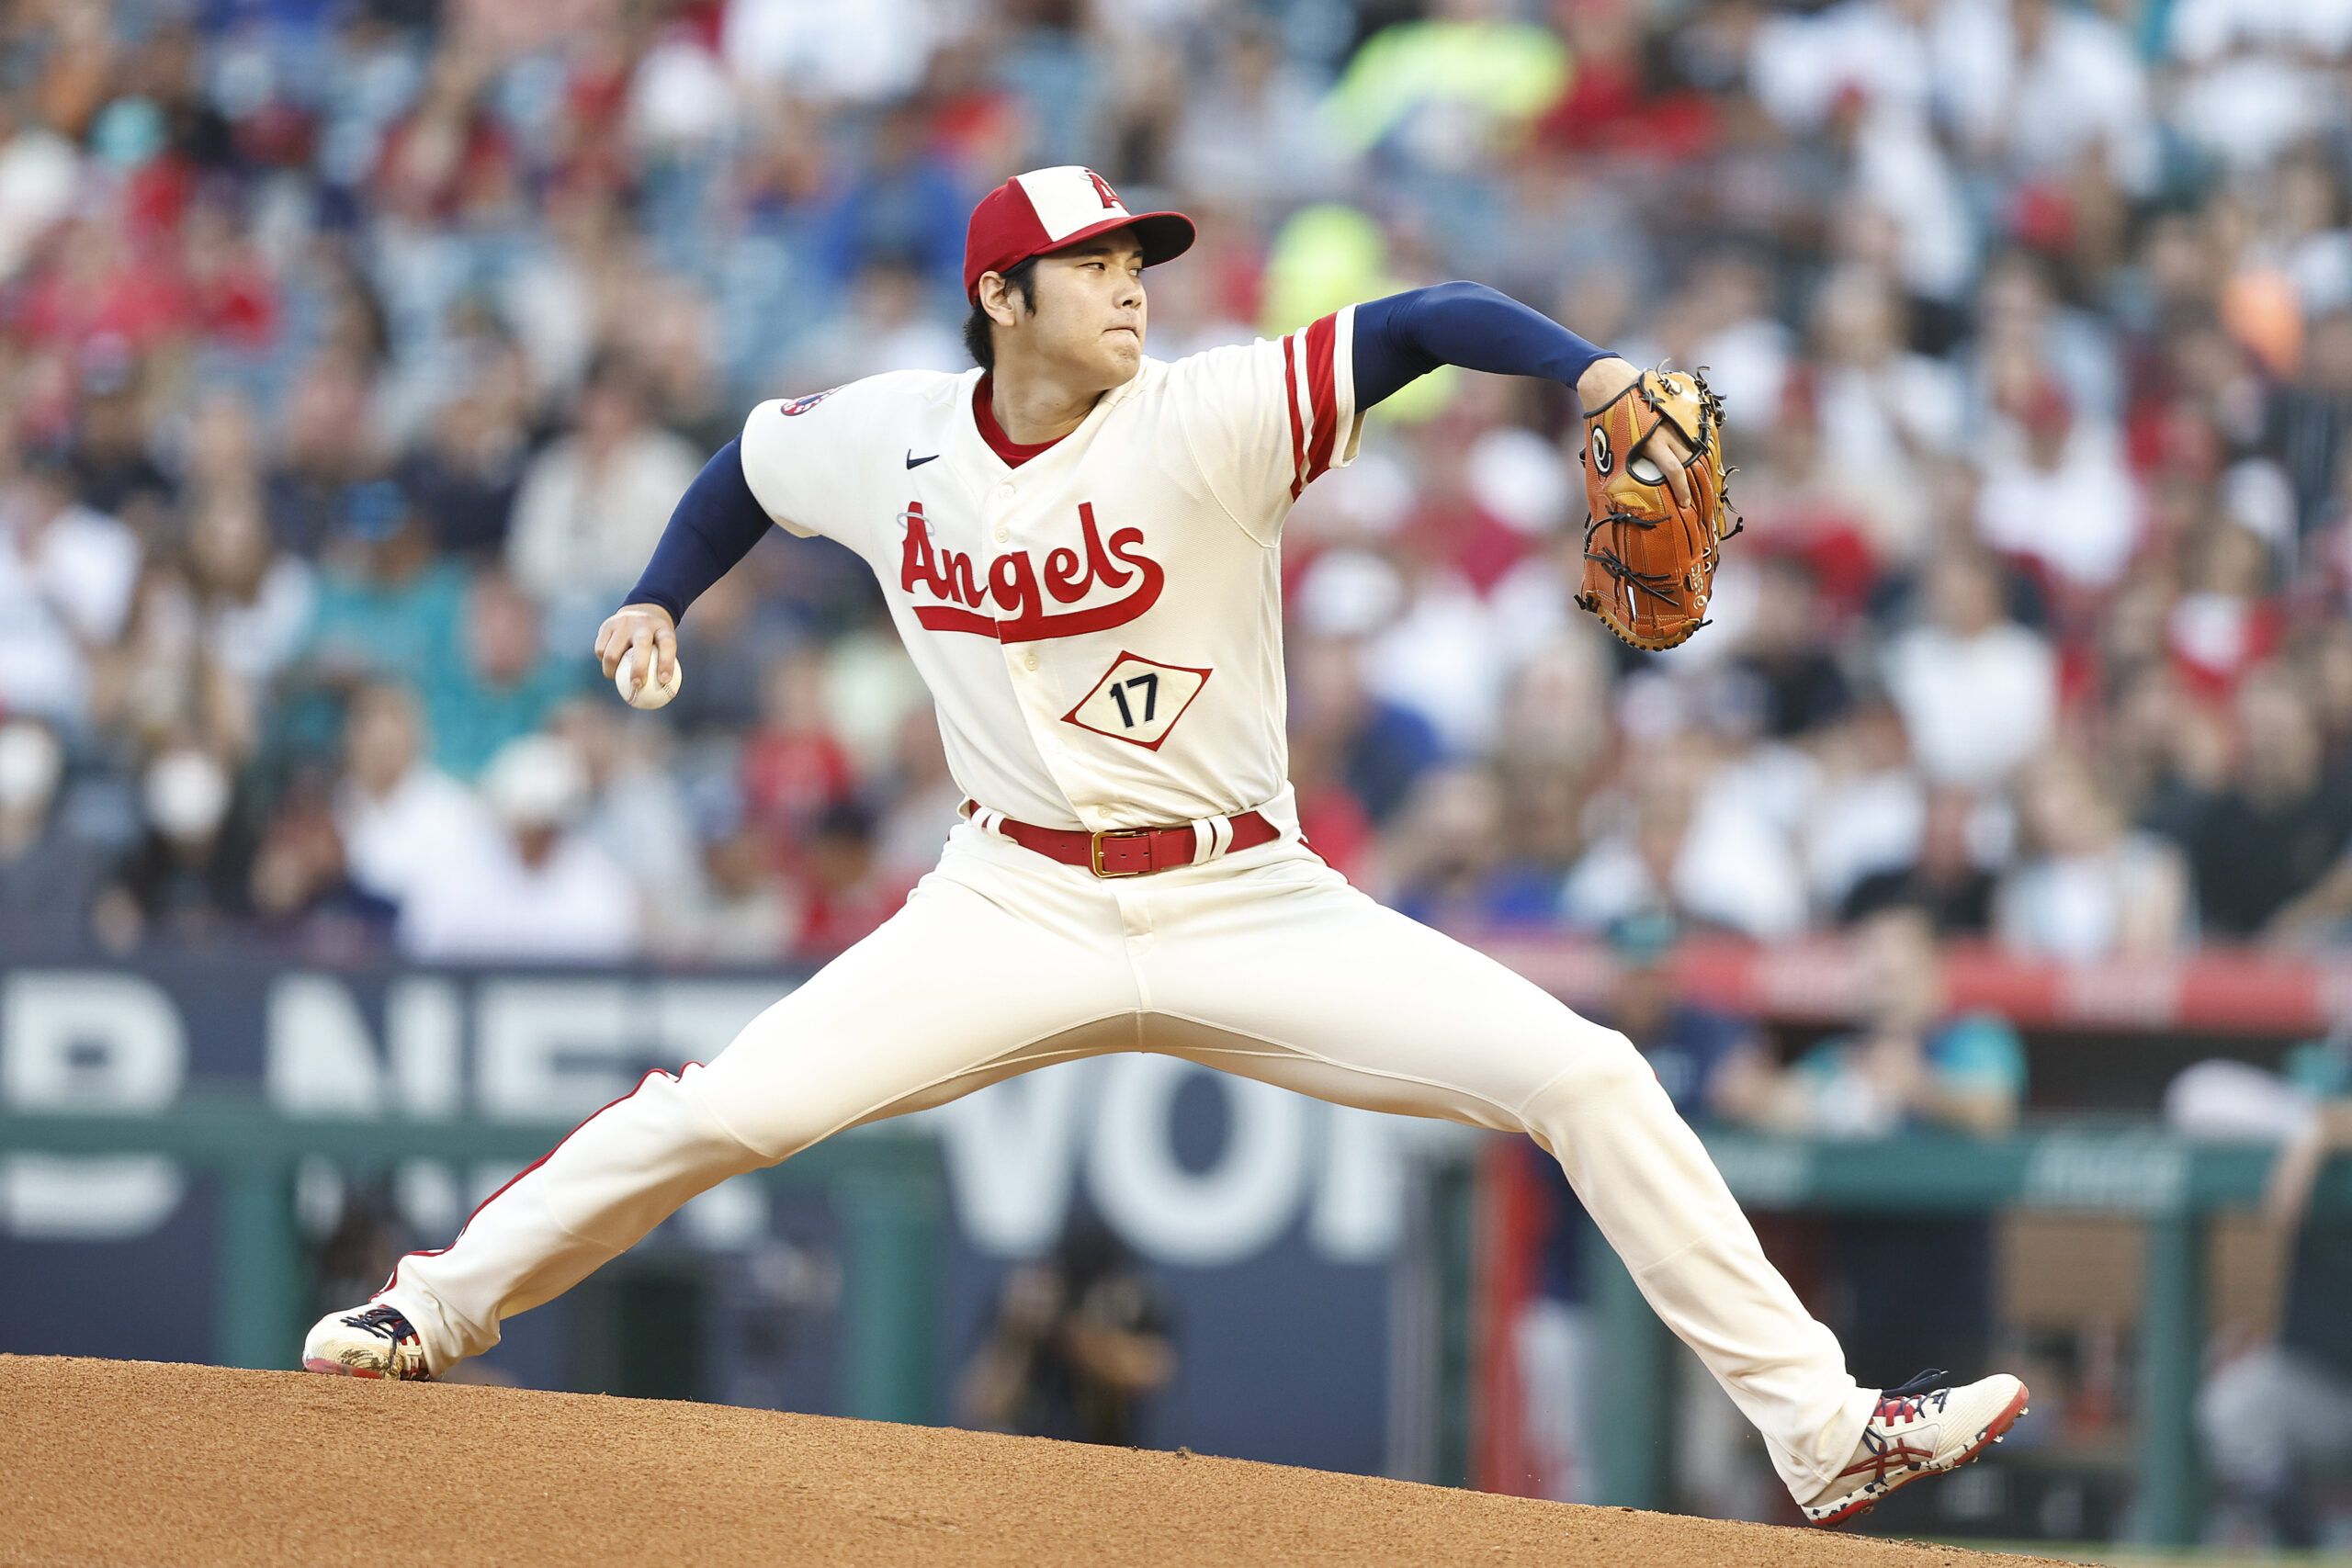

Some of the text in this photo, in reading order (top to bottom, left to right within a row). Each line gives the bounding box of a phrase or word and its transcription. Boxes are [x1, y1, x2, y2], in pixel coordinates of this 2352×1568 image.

[1084, 169, 1132, 217] A
[899, 501, 1165, 645] Angels
[1109, 671, 1159, 729] 17
